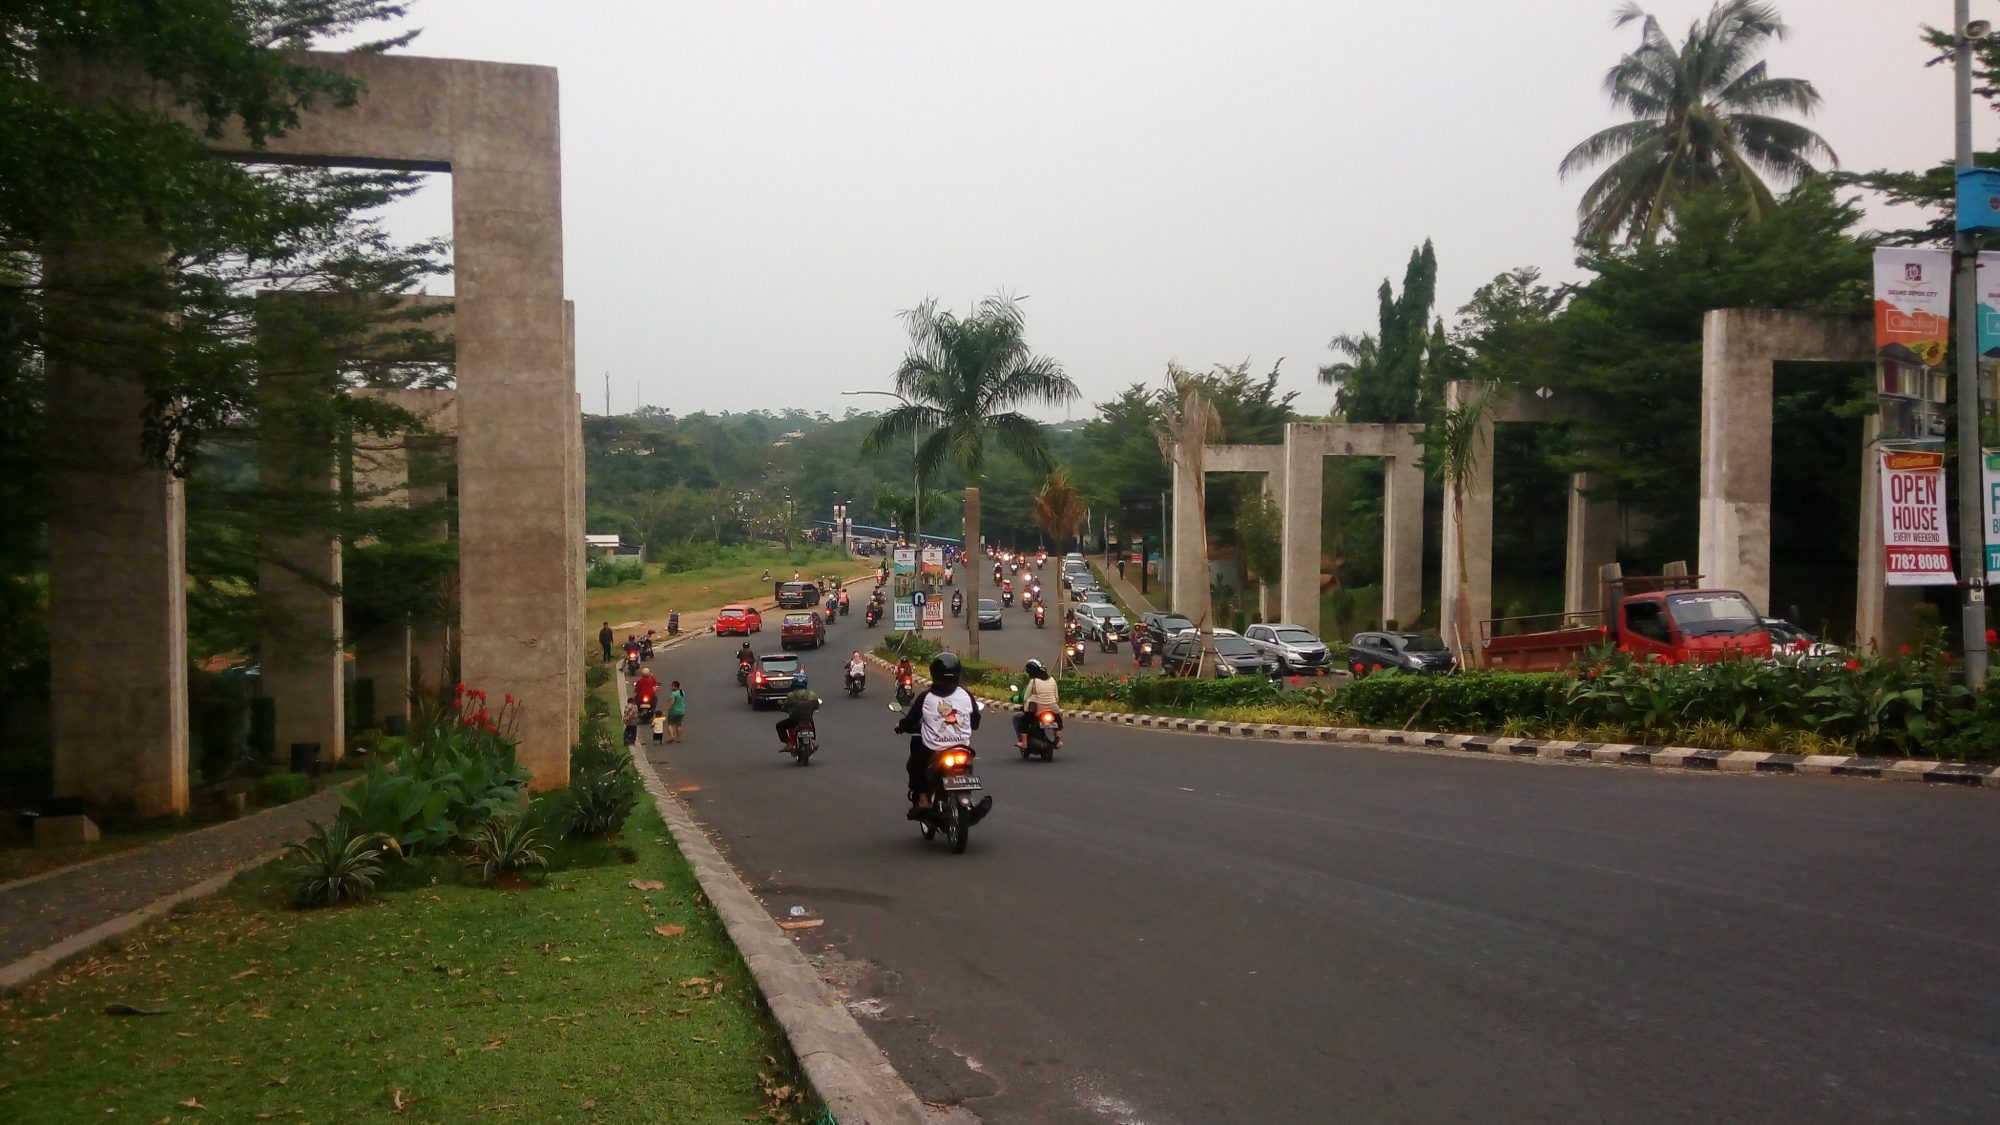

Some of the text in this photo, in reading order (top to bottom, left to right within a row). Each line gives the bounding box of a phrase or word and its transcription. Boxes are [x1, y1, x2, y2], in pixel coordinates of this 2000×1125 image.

[1891, 474, 1937, 505] OPEN
[1892, 506, 1939, 531] HOUSE
[1893, 532, 1940, 543] EVERY WEEKEND
[1890, 554, 1949, 570] 7782 8080
[897, 605, 913, 614] FREE
[926, 602, 941, 611] OPEN
